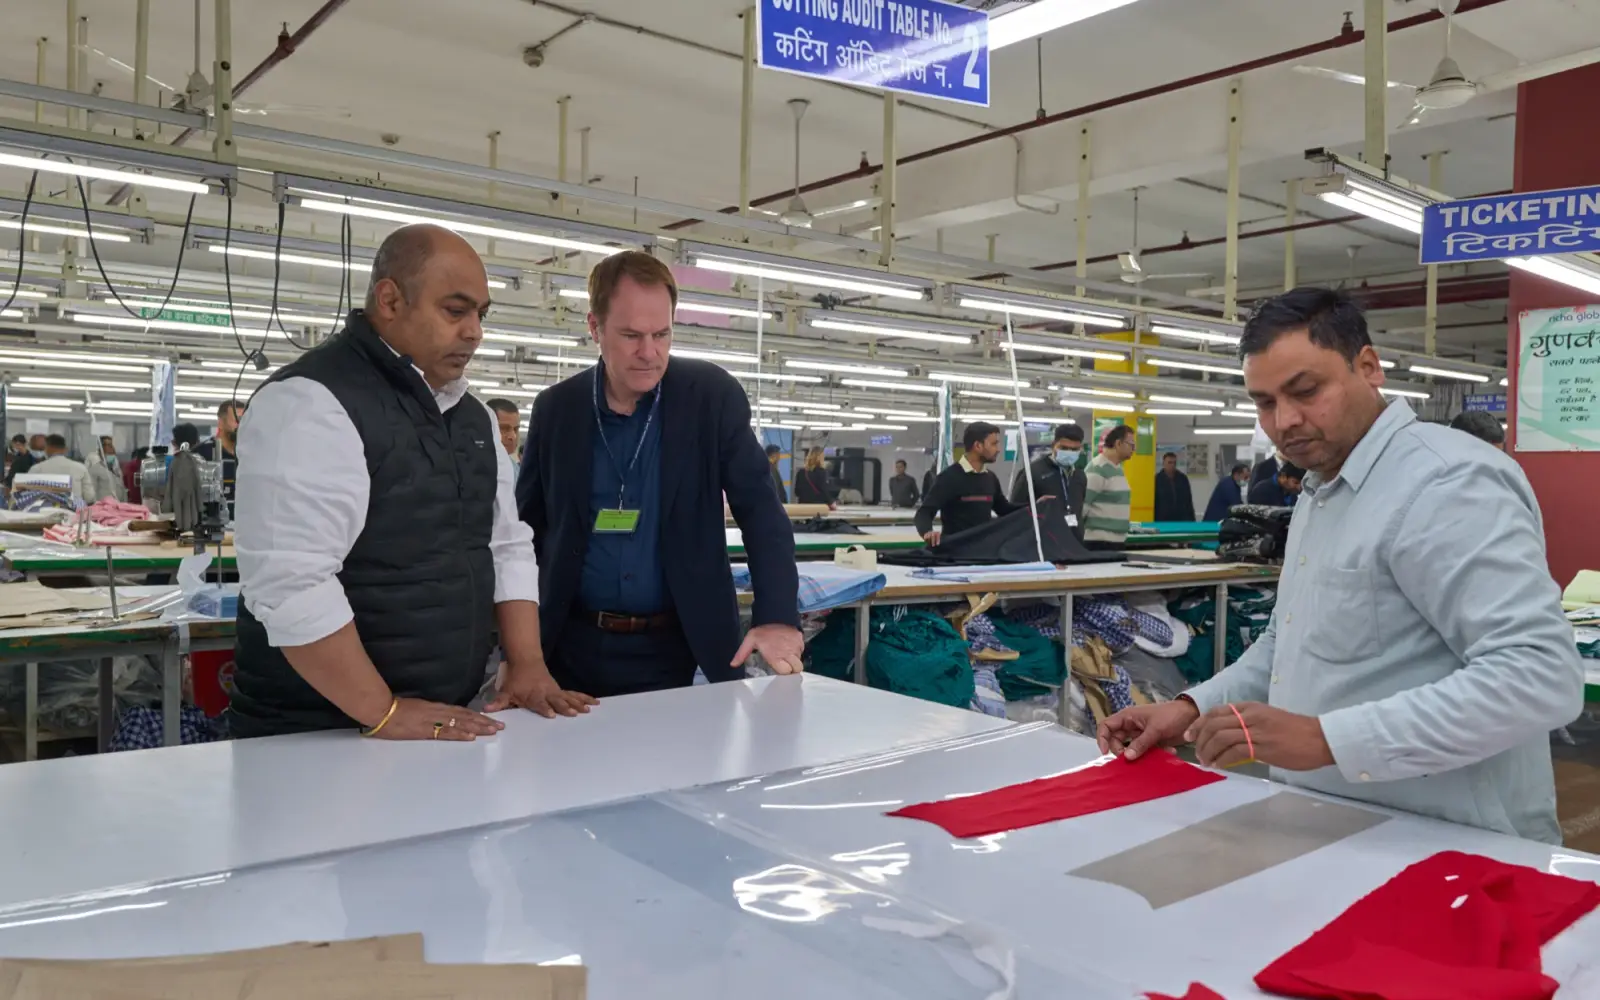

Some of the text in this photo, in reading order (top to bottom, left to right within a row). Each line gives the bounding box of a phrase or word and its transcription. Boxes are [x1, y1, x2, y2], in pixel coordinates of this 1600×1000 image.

[842, 0, 884, 31] AUDIT
[887, 1, 930, 40] TABLE
[773, 27, 828, 66] कटिंग
[963, 24, 980, 89] 2
[1440, 192, 1600, 228] TICKETIN
[1529, 329, 1600, 357] गुणव
